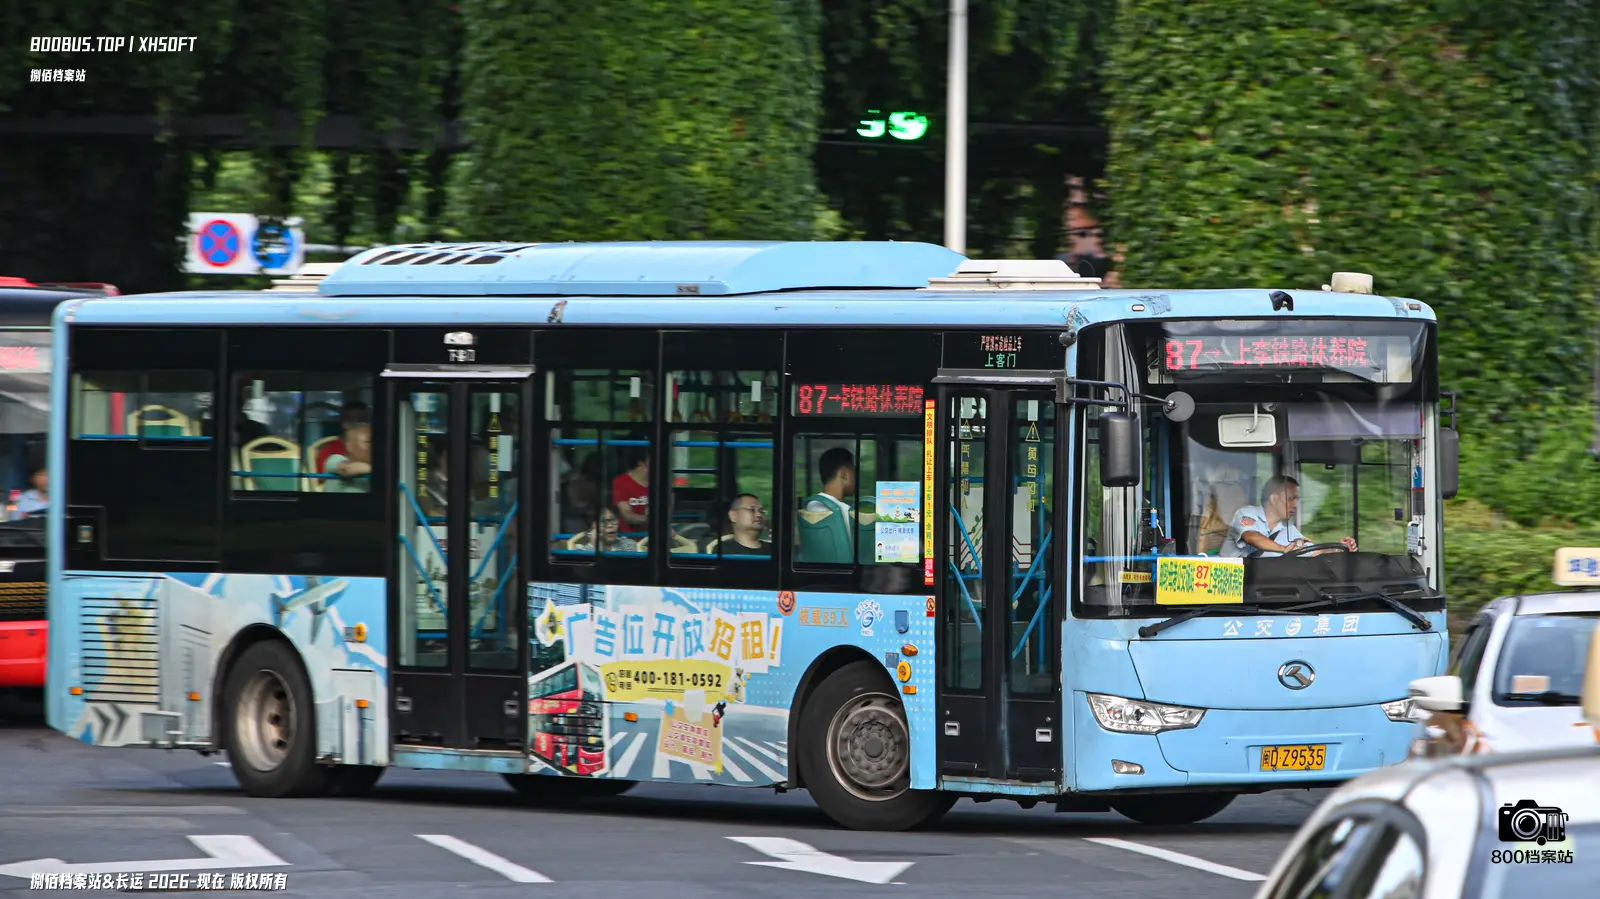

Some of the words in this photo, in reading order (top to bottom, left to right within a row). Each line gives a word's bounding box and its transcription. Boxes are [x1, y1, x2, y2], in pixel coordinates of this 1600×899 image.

[984, 352, 1016, 368] 上客门
[1165, 340, 1204, 370] 87
[1233, 337, 1368, 366] 上李铁路休养院
[799, 384, 829, 414] 87
[1196, 565, 1209, 580] 87
[799, 607, 849, 627] 核载89人
[634, 670, 721, 688] 400-181-0592
